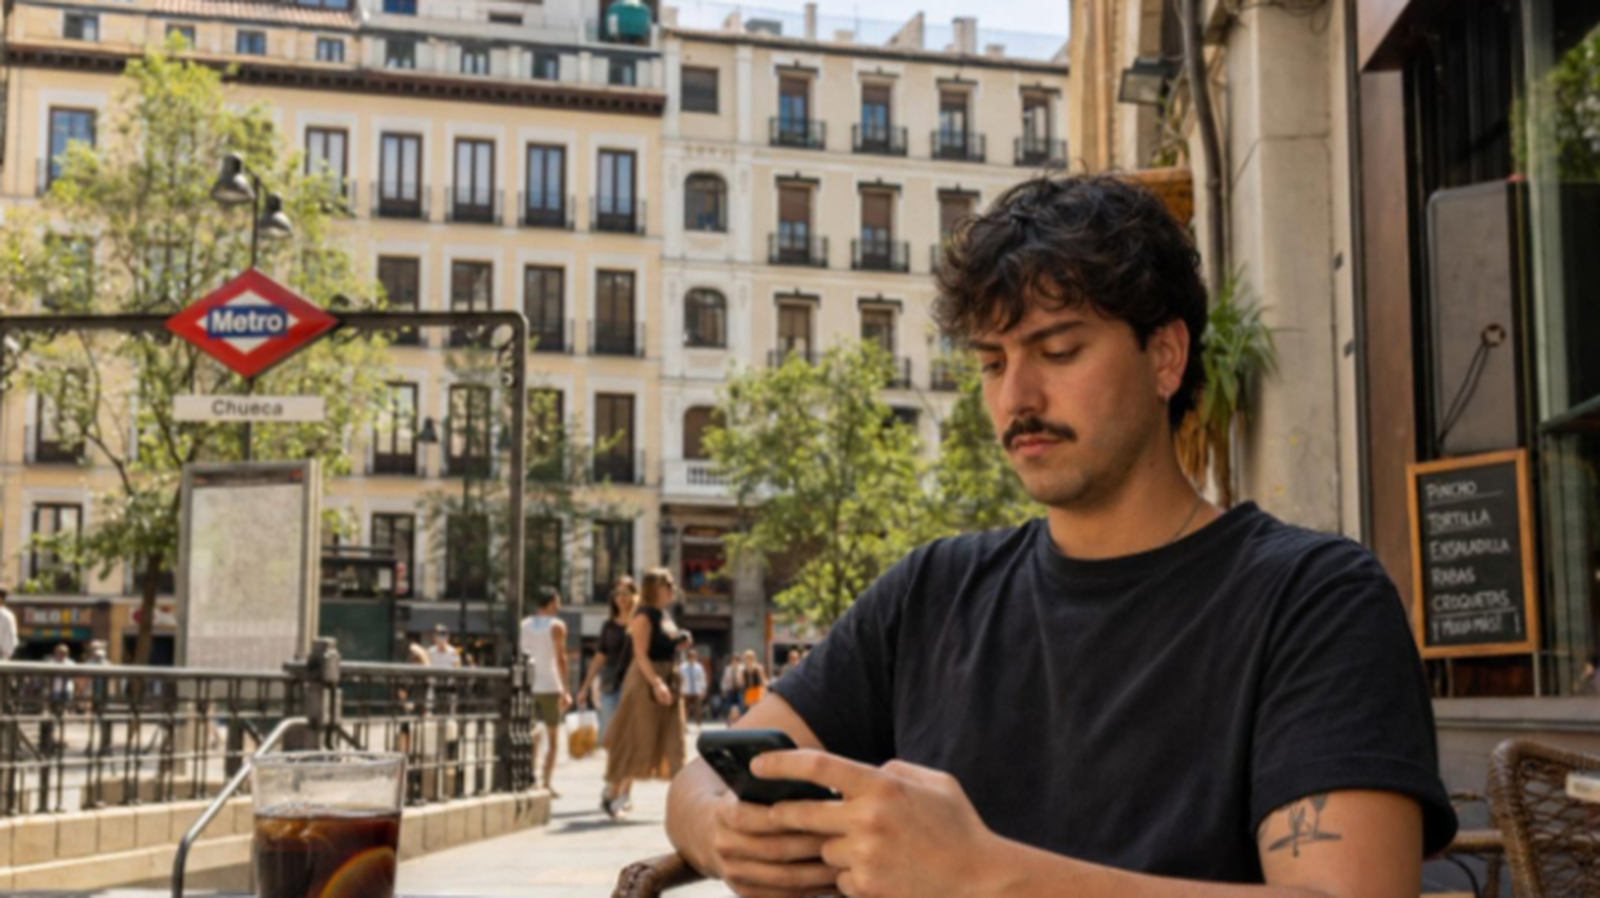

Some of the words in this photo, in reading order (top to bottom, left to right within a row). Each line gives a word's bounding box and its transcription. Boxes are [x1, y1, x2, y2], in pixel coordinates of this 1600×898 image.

[211, 309, 283, 333] Metro
[211, 400, 284, 416] Chueca
[1427, 509, 1491, 532] TORTILLA
[1431, 566, 1477, 588] RABAS
[1432, 589, 1510, 613] CROQUETAS
